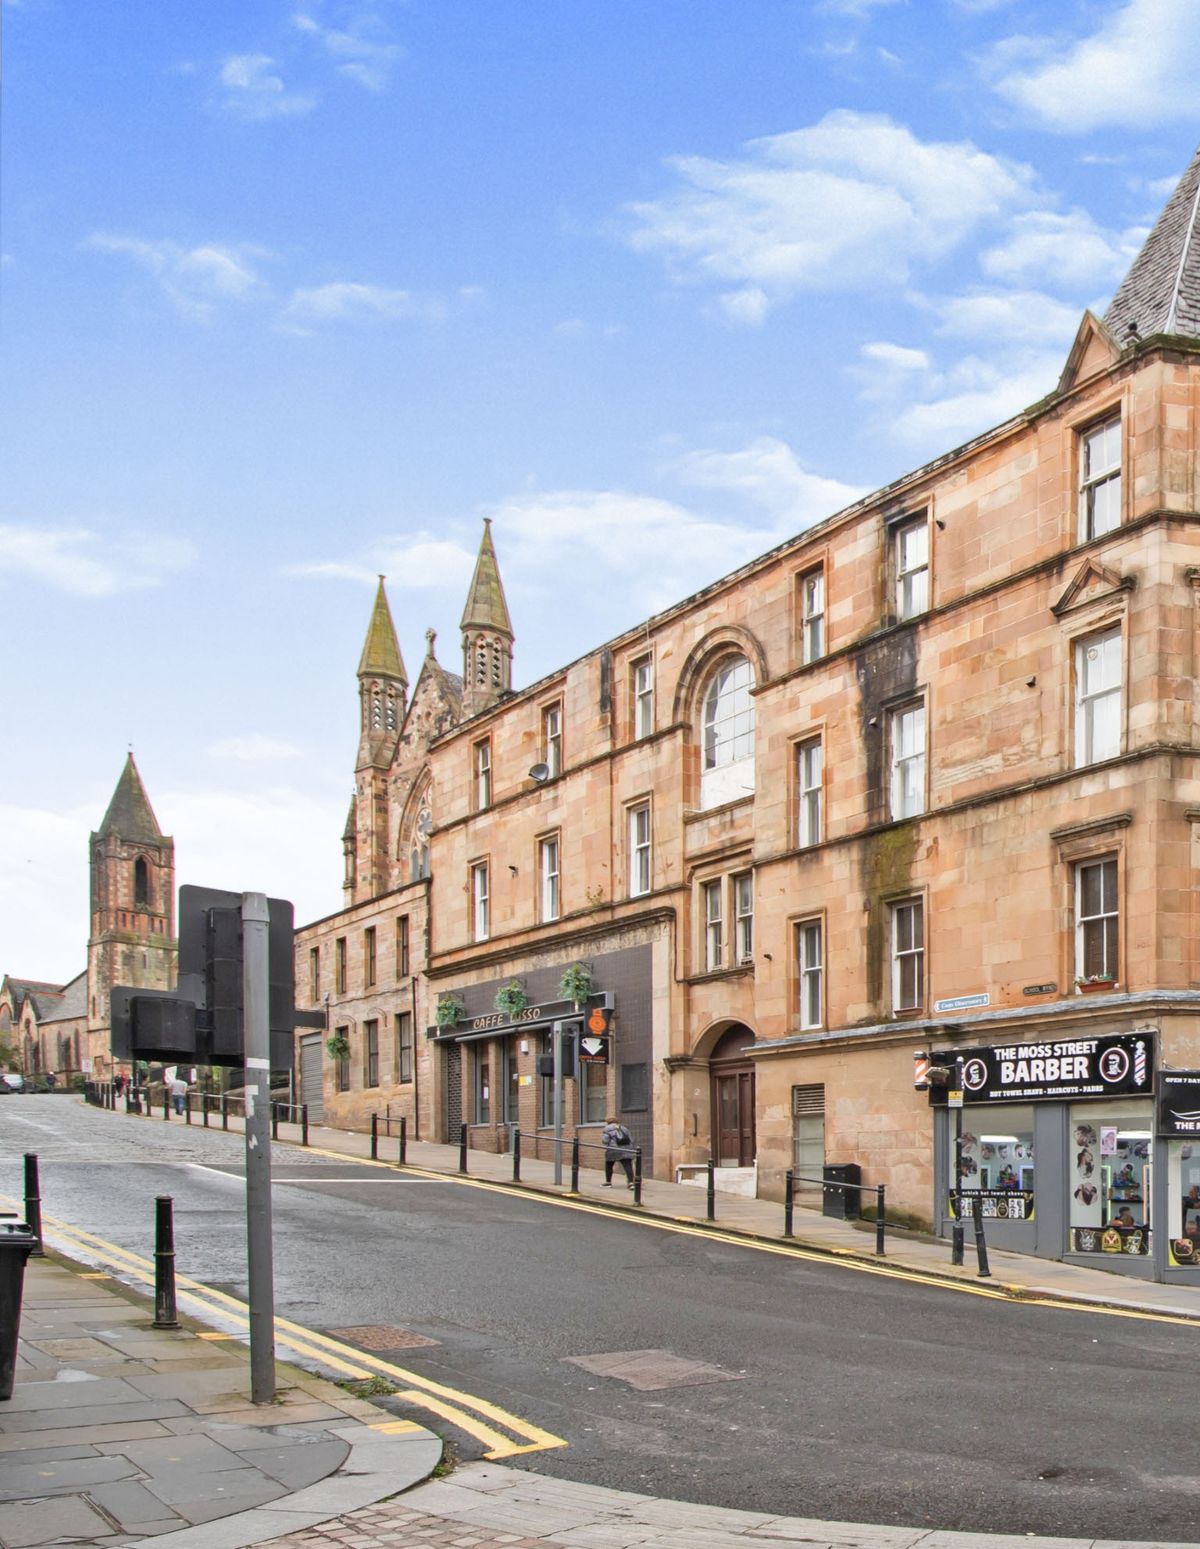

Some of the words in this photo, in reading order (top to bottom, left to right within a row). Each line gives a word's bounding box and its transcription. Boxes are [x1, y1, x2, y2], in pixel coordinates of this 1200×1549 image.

[473, 1014, 504, 1030] CAFFE
[994, 1048, 1016, 1061] THE
[1018, 1046, 1052, 1060] MOSS
[1054, 1041, 1098, 1056] STREET
[1001, 1056, 1089, 1084] BARBER
[1174, 1122, 1195, 1130] THE
